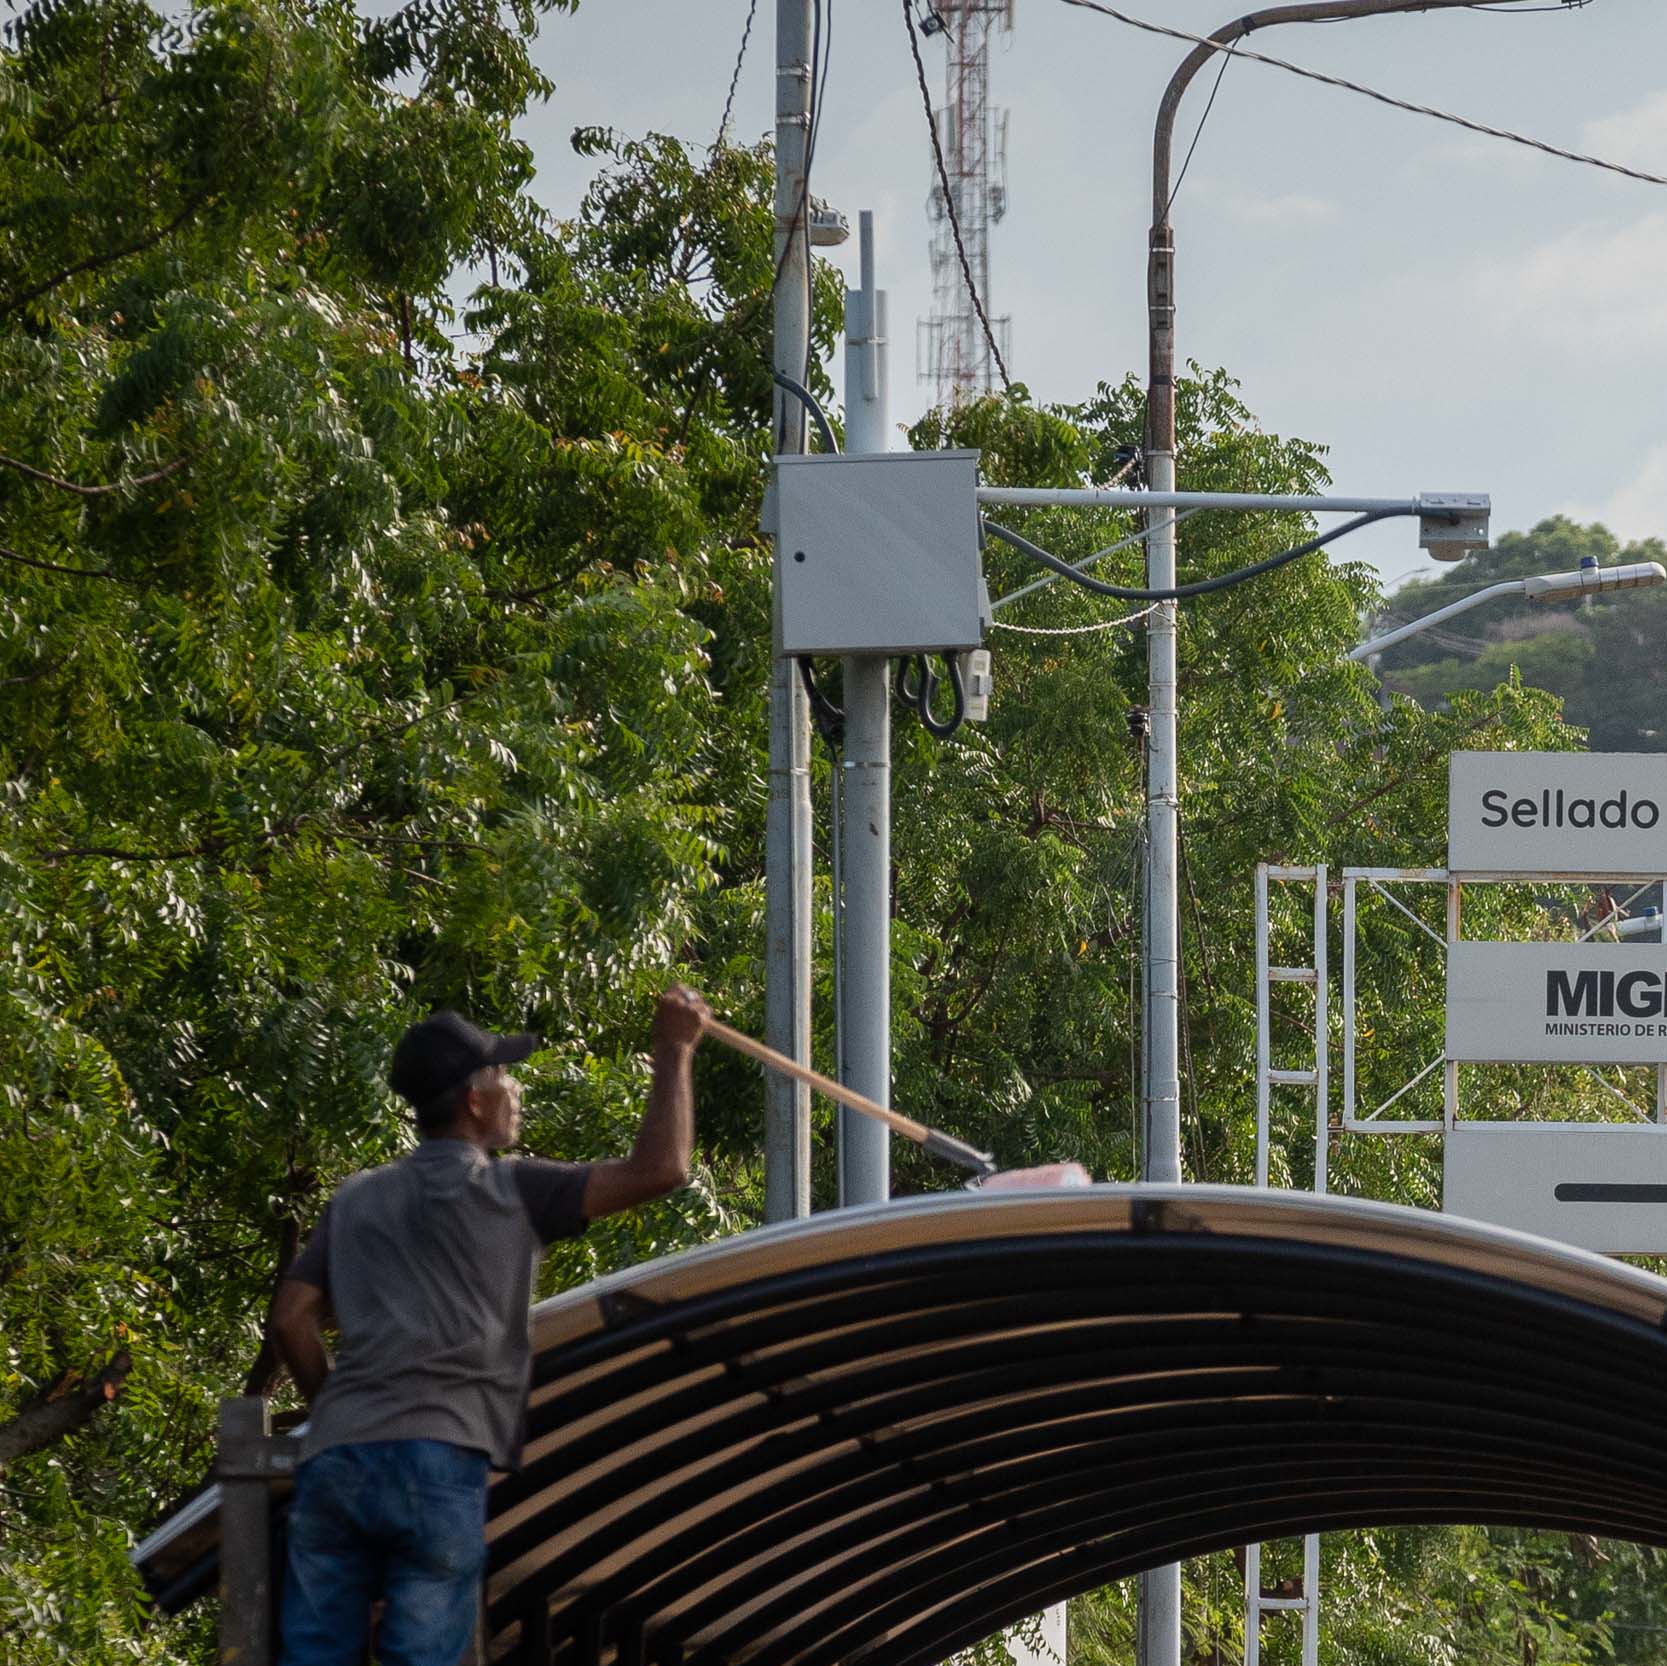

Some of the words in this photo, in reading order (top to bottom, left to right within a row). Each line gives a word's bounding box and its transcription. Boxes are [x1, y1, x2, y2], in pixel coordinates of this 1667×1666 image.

[1481, 788, 1660, 830] Sellado
[1545, 1022, 1631, 1037] MINISTERIO
[1634, 1023, 1655, 1037] DE
